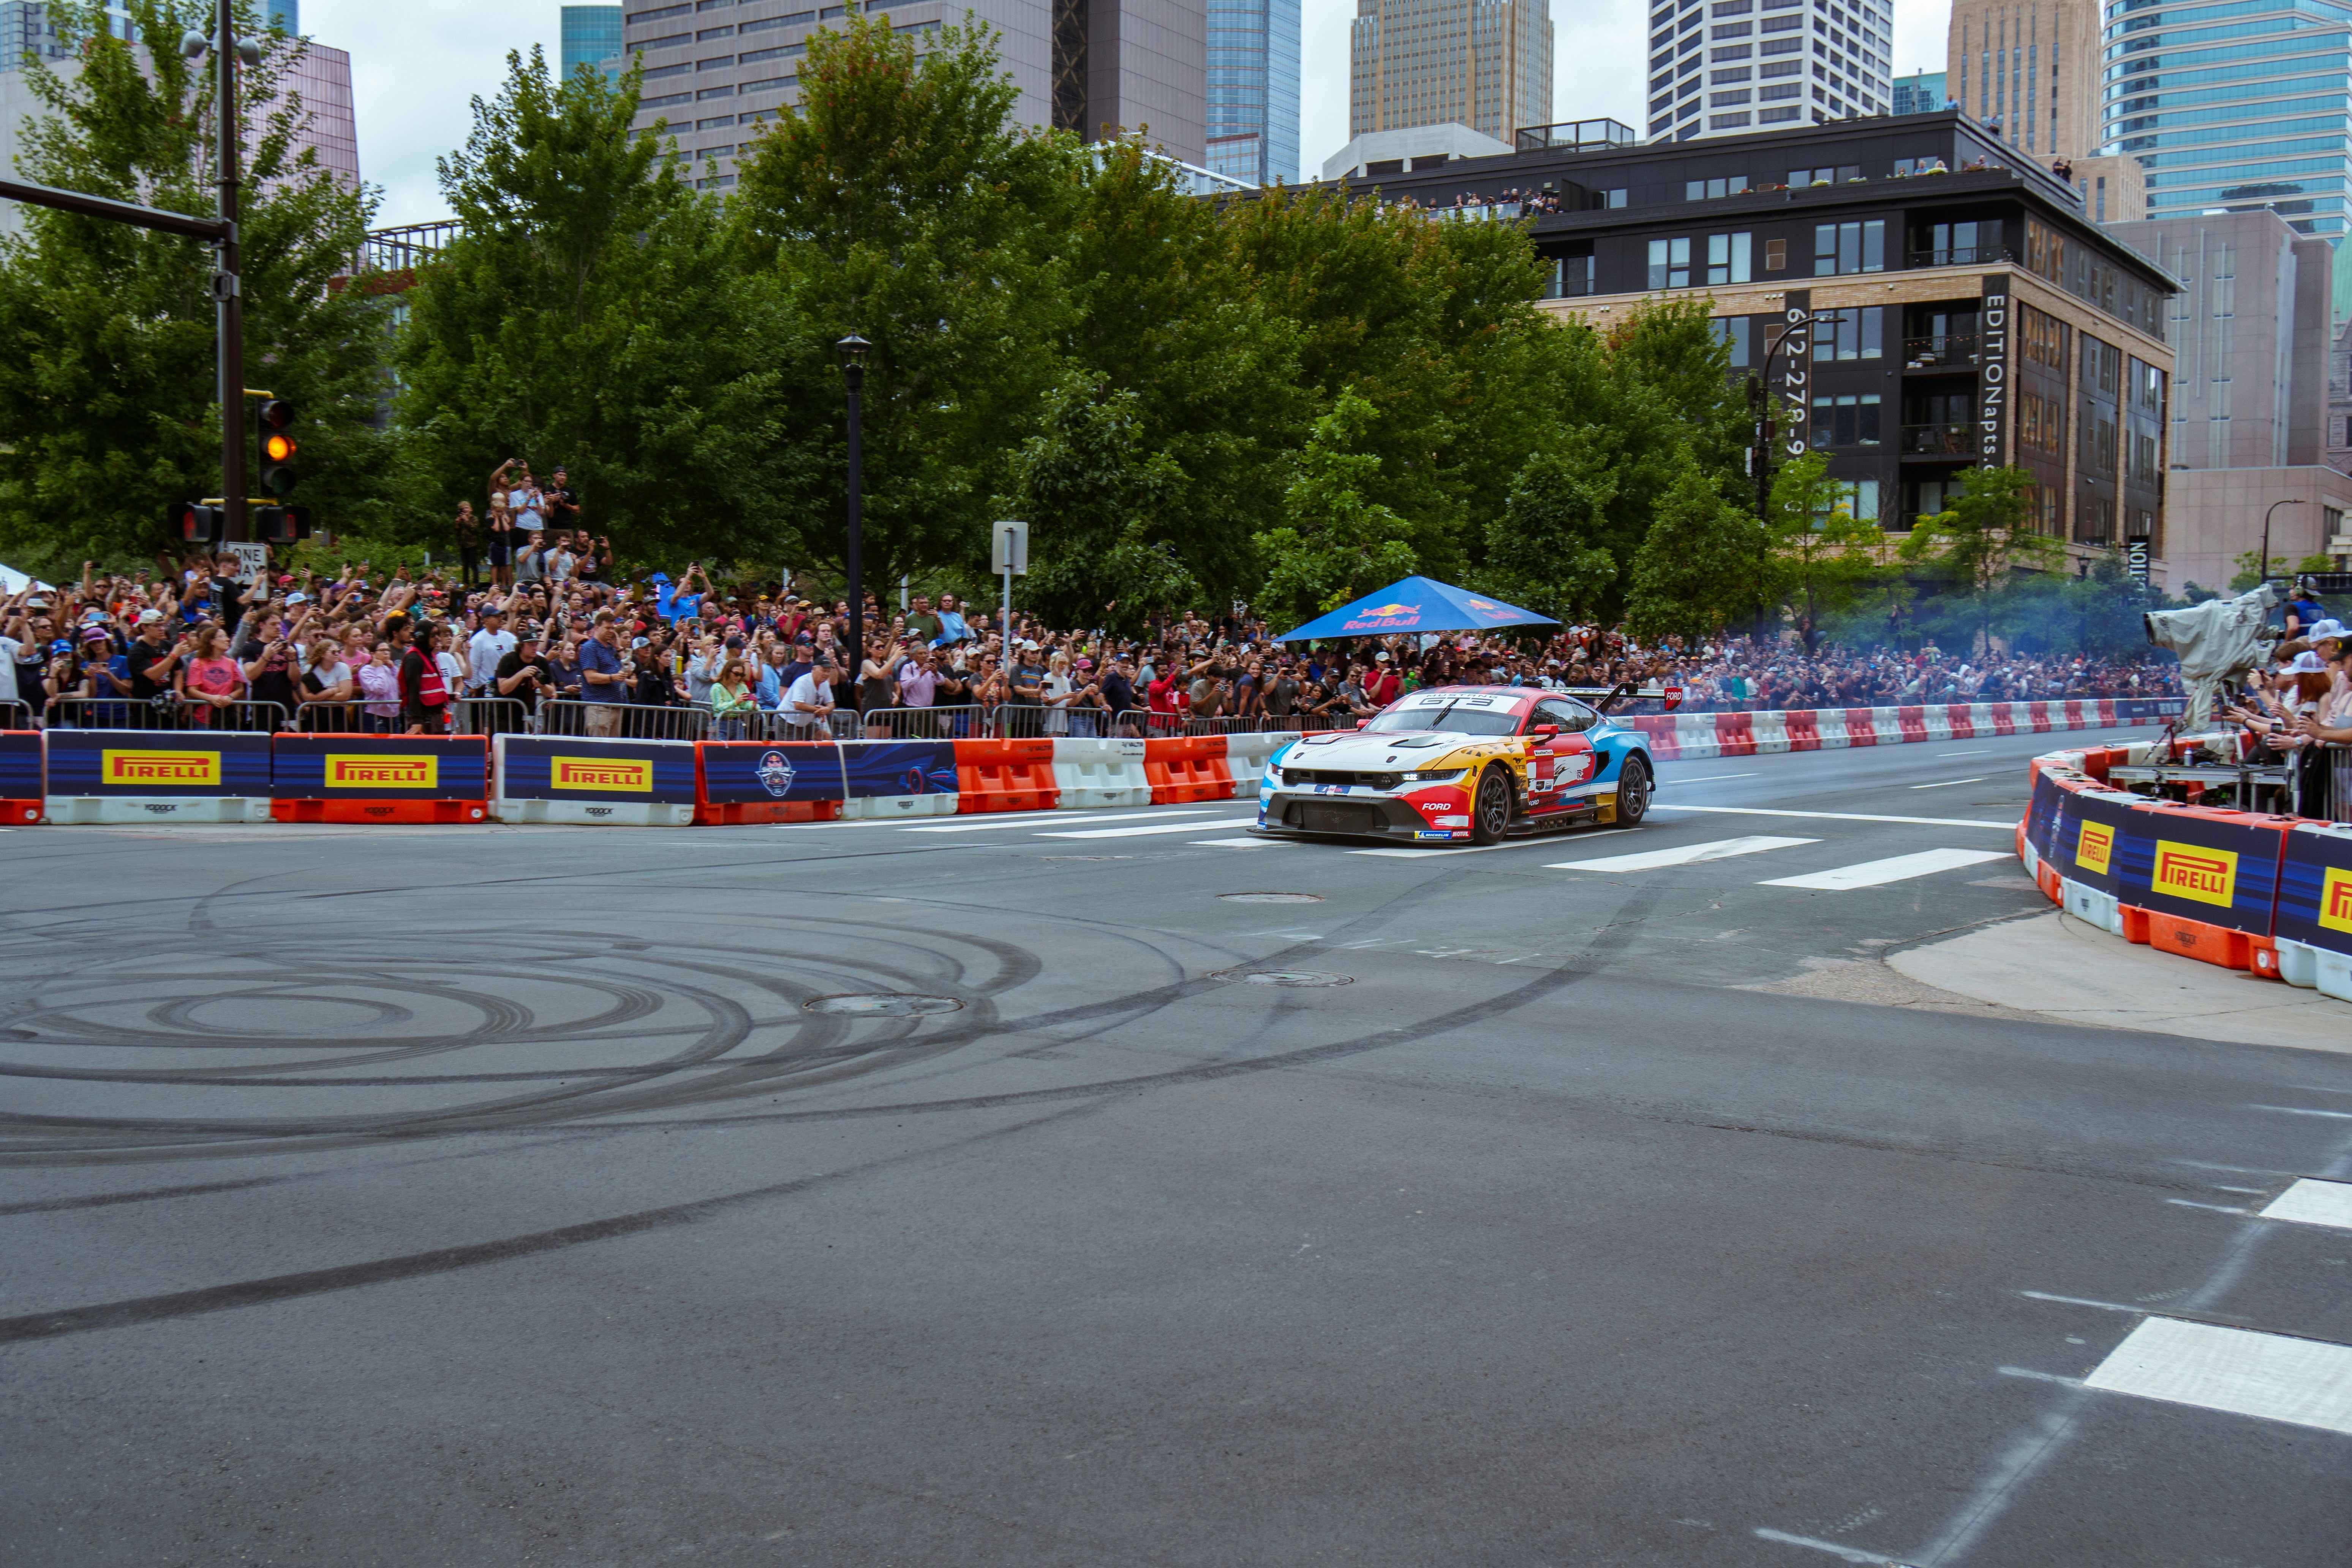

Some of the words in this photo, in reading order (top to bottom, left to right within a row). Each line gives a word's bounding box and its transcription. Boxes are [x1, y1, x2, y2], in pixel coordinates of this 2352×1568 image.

[233, 548, 261, 561] ONE
[1342, 618, 1382, 630] Red
[1380, 616, 1421, 627] Bull
[1419, 697, 1494, 706] GT3
[113, 756, 210, 778] PIRELLI
[335, 761, 427, 781] PIRELLI
[560, 763, 643, 785] PIRELLI
[2080, 829, 2109, 864] PIRELLI
[2160, 851, 2228, 894] PIRELLI
